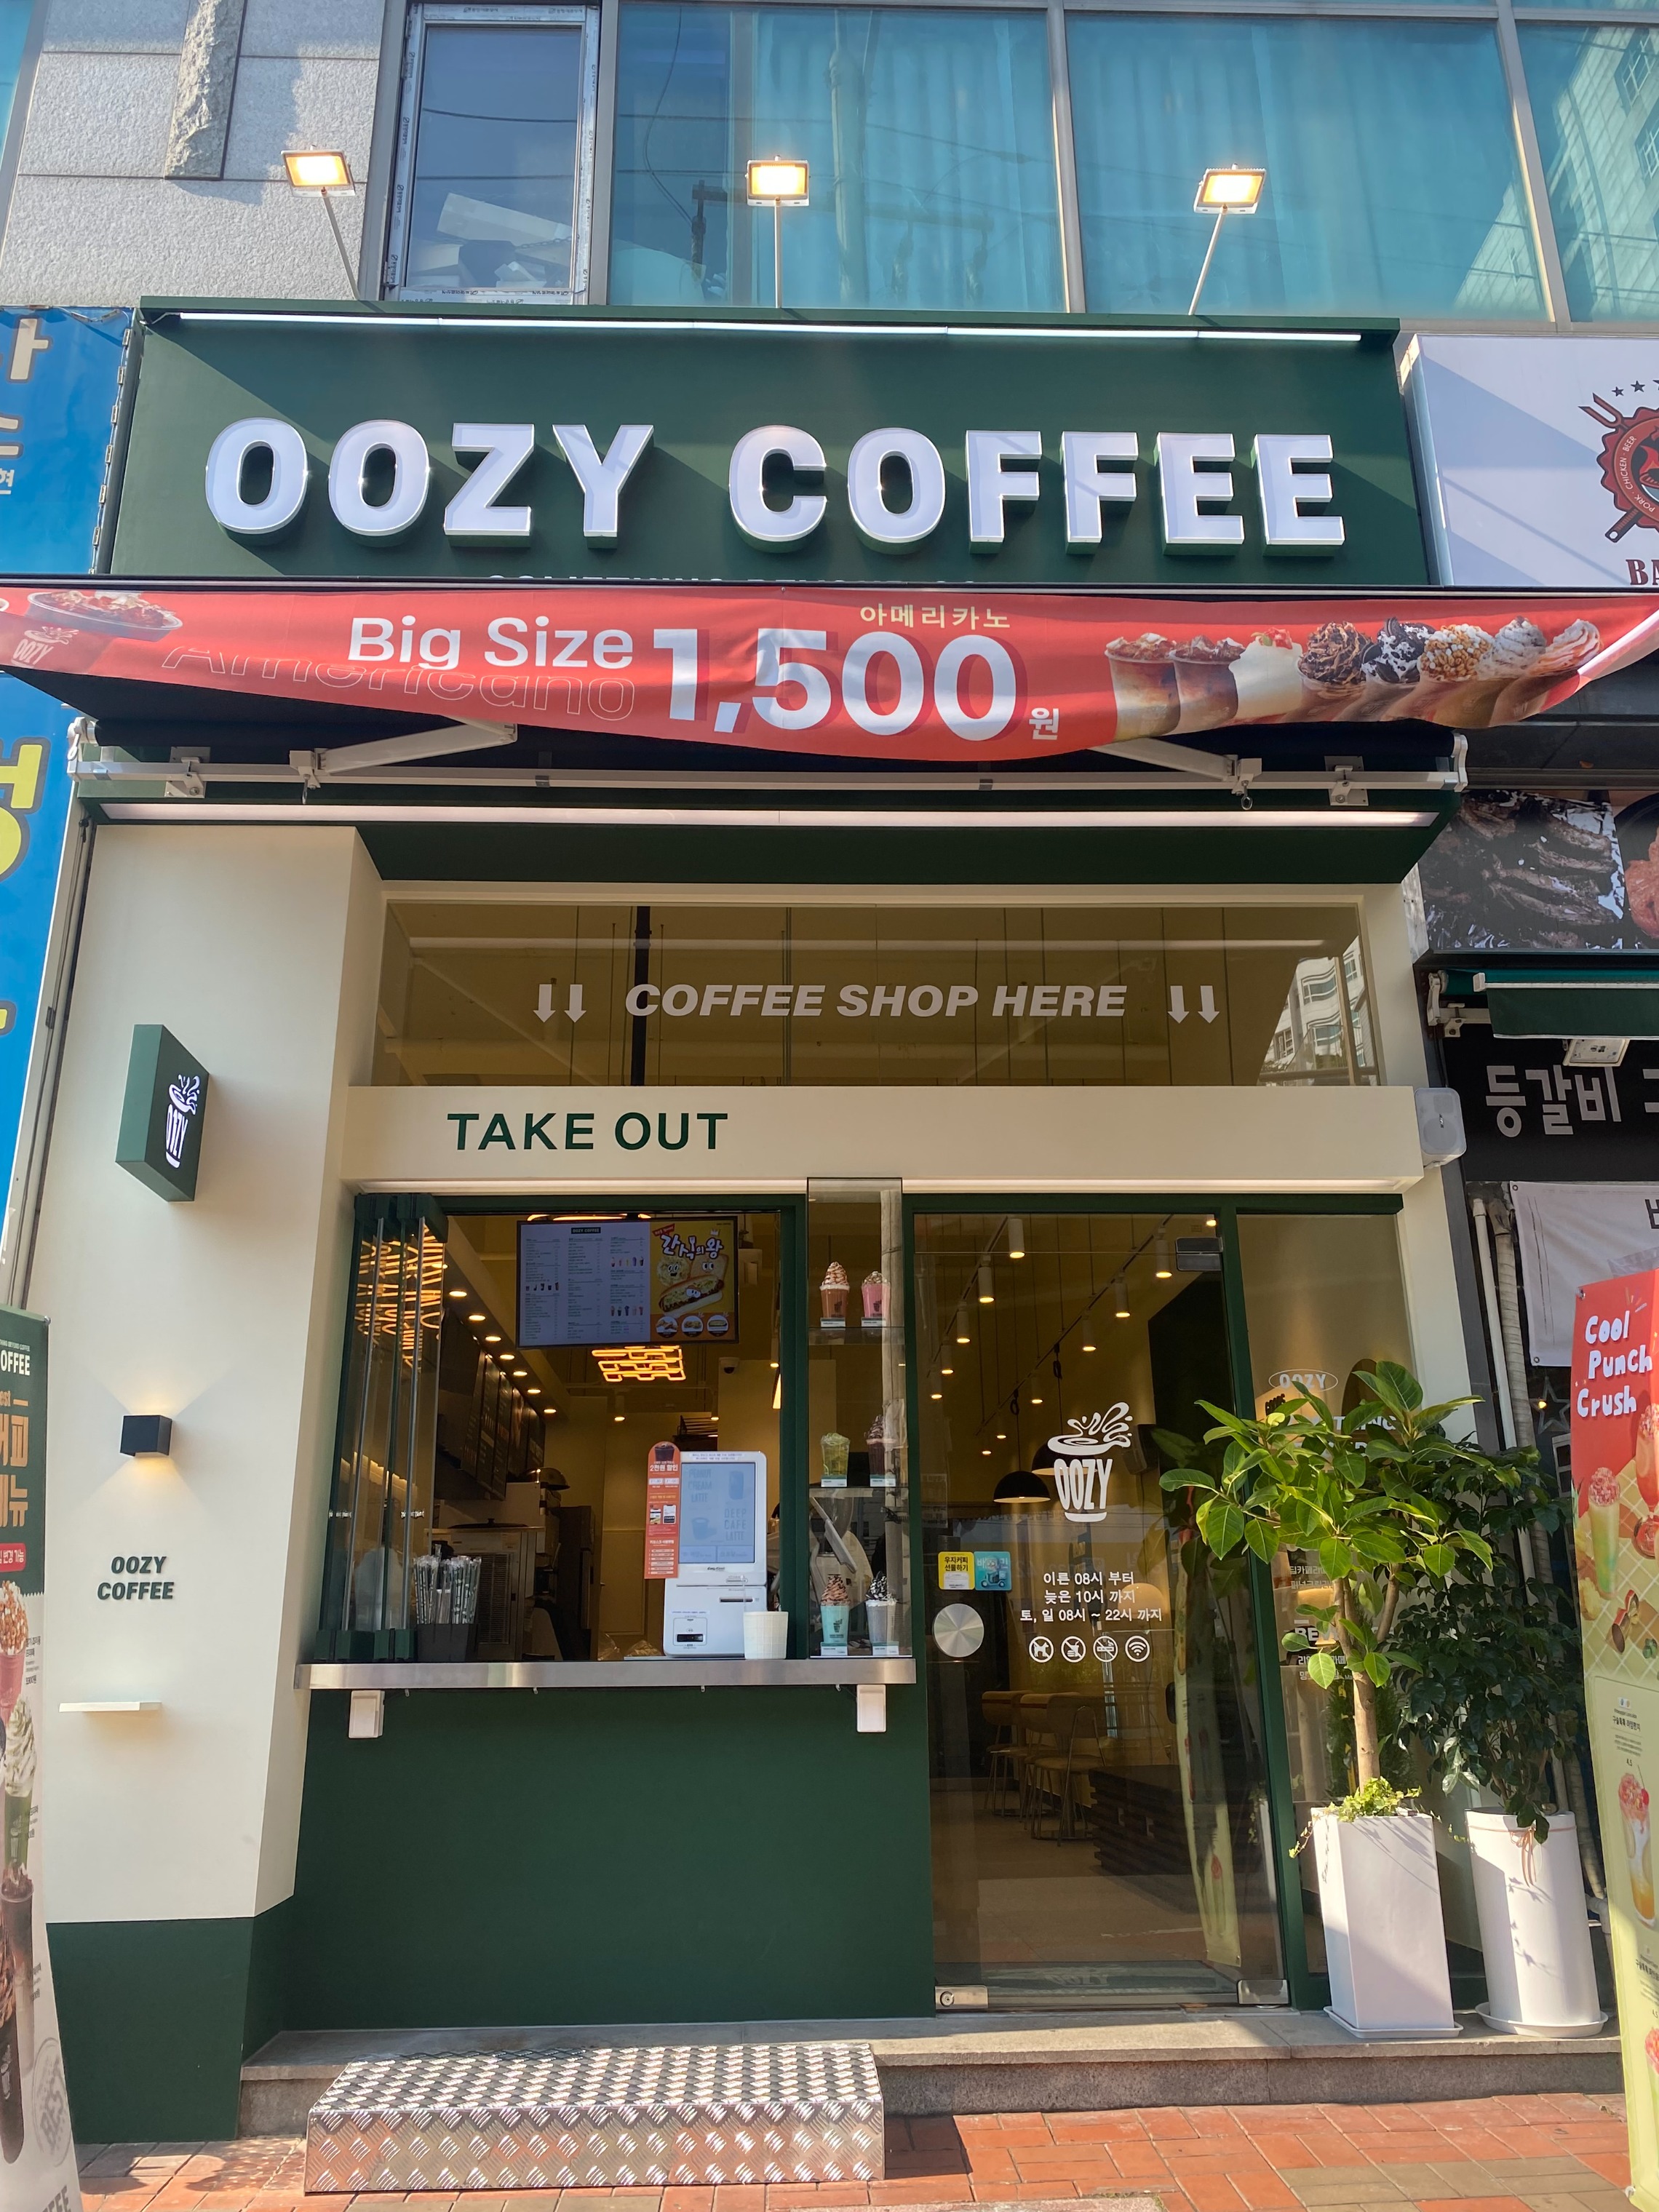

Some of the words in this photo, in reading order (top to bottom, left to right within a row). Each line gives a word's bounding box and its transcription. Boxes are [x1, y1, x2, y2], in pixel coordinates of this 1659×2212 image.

[1622, 436, 1637, 452] BEER
[205, 417, 655, 540] OOZY
[728, 424, 1345, 547] COFFEE
[1619, 457, 1634, 490] CHICKEN
[1634, 494, 1655, 513] PORK
[860, 602, 1011, 631] 아메리카노
[12, 638, 54, 666] OOZY
[347, 616, 461, 670] Big
[484, 616, 634, 669] Size
[625, 984, 825, 1017] COFFEE
[836, 984, 979, 1017] SHOP
[992, 985, 1127, 1017] HERE
[1486, 1064, 1622, 1138] 등갈비
[447, 1113, 595, 1150] TAKE
[614, 1112, 728, 1150] OUT
[1585, 1310, 1630, 1344] Cool
[0, 1349, 31, 1376] OFFEE
[1588, 1345, 1653, 1380] Punch
[1577, 1385, 1636, 1418] Crush
[1054, 1458, 1113, 1511] OOZY
[111, 1556, 167, 1575] OOZY
[1043, 1571, 1070, 1586] 이른
[1074, 1572, 1103, 1586] 08시
[1108, 1571, 1134, 1586] 부터
[97, 1582, 175, 1600] COFFEE
[1044, 1589, 1072, 1604] 늦은
[1075, 1589, 1104, 1604] 10시
[1109, 1589, 1136, 1604] 까지
[1019, 1609, 1037, 1623] 토,
[1041, 1608, 1054, 1622] 일
[1058, 1608, 1086, 1622] 08시
[1105, 1608, 1132, 1622] 22시
[1137, 1608, 1163, 1622] 까지
